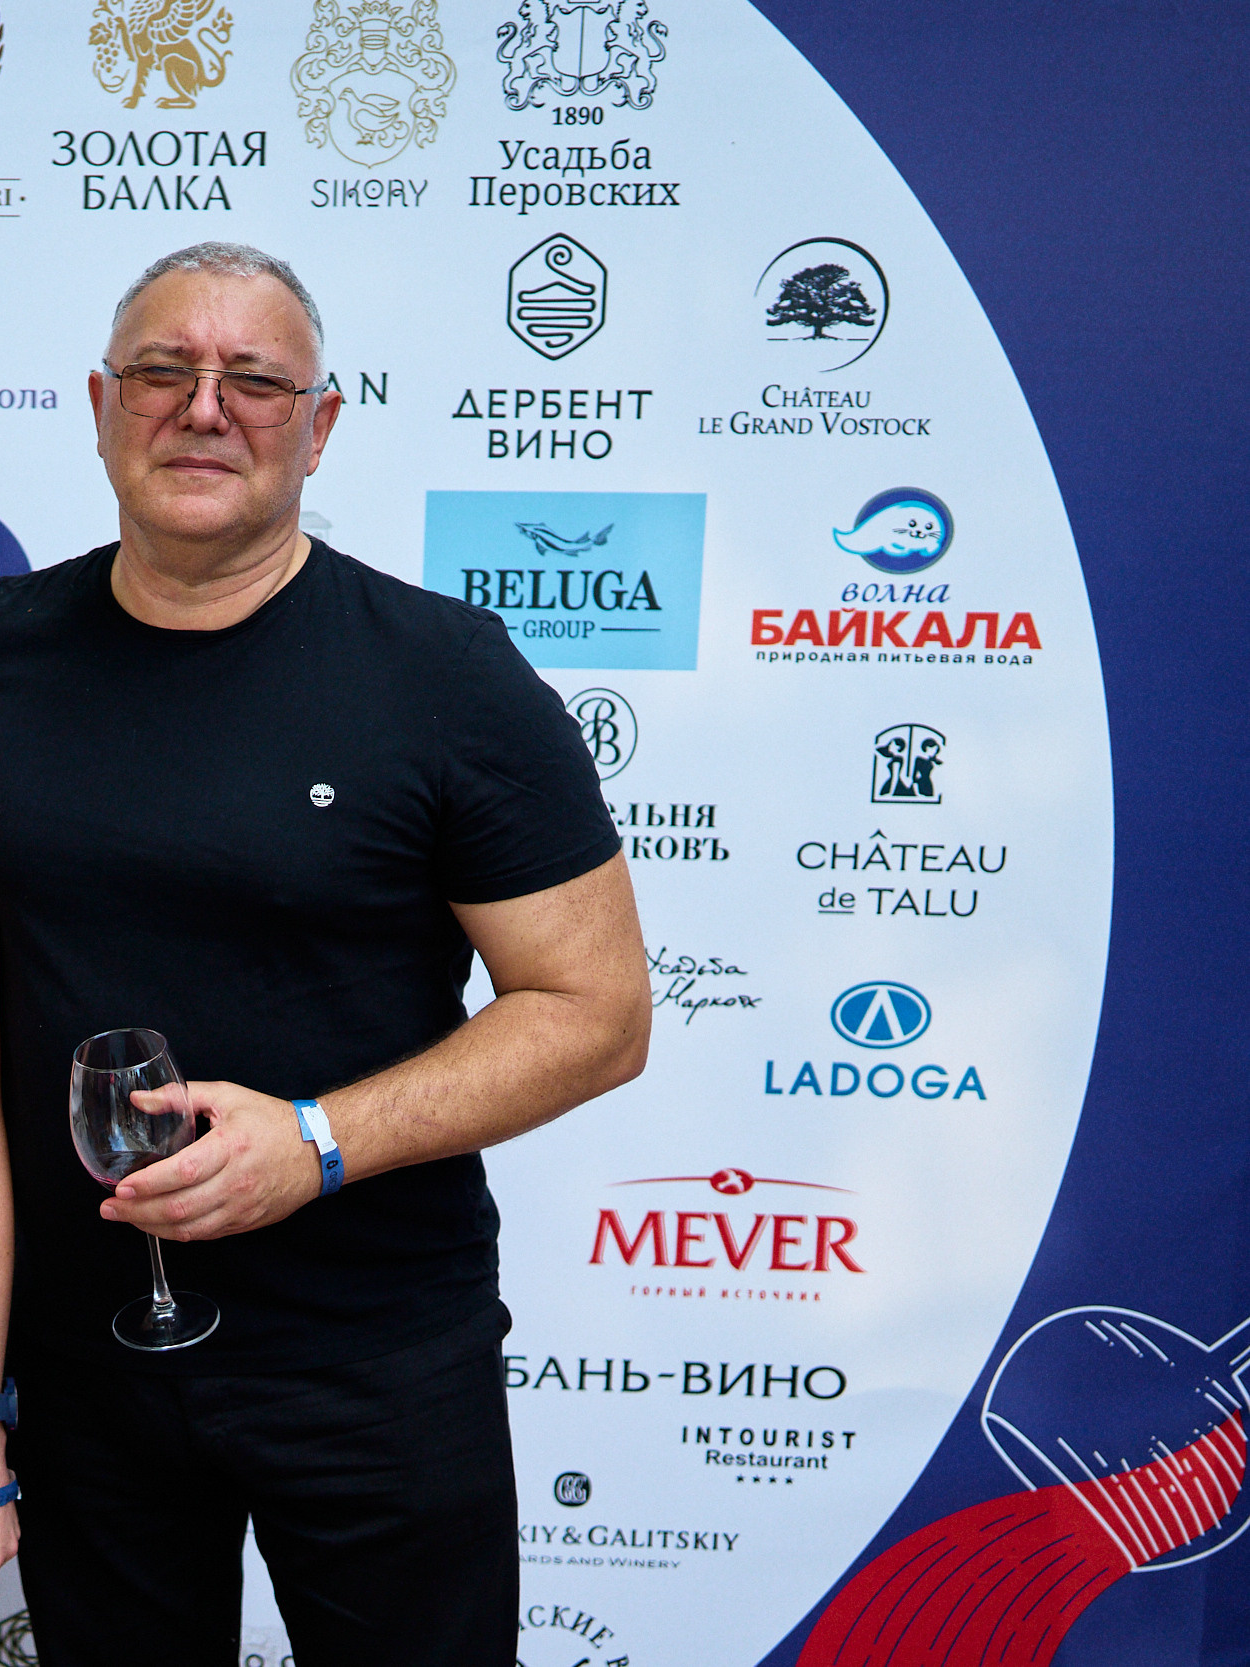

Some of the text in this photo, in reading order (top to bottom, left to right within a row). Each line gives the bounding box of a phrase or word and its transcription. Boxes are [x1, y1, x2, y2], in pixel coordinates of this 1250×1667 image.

[553, 106, 604, 125] 1890
[52, 130, 266, 166] ЗОЛОТАЯ
[499, 138, 651, 177] Усадьба
[83, 175, 231, 210] БАЛКА
[311, 179, 428, 208] SIKORY
[469, 176, 680, 215] Перовских
[452, 389, 652, 419] ДЕРБЕНТ
[488, 429, 612, 459] ВИНО
[461, 567, 663, 612] BELUGA
[841, 583, 949, 603] волна
[523, 620, 595, 639] GROUP
[749, 608, 1043, 650] БАЙКАЛА
[757, 651, 1032, 665] природная питьевая вода
[797, 829, 1006, 873] CHÂTEAU
[817, 884, 978, 917] de TALU
[765, 1060, 987, 1100] LADOGA
[589, 1209, 863, 1273] MEVER
[631, 1286, 820, 1301] ГОРНЫЙ ИСТОЧНИК
[503, 1353, 849, 1402] БАНЬ-ВИНО
[681, 1424, 858, 1451] INTOURIST
[704, 1449, 830, 1471] Restaurant
[587, 1525, 742, 1552] GALITSKIY
